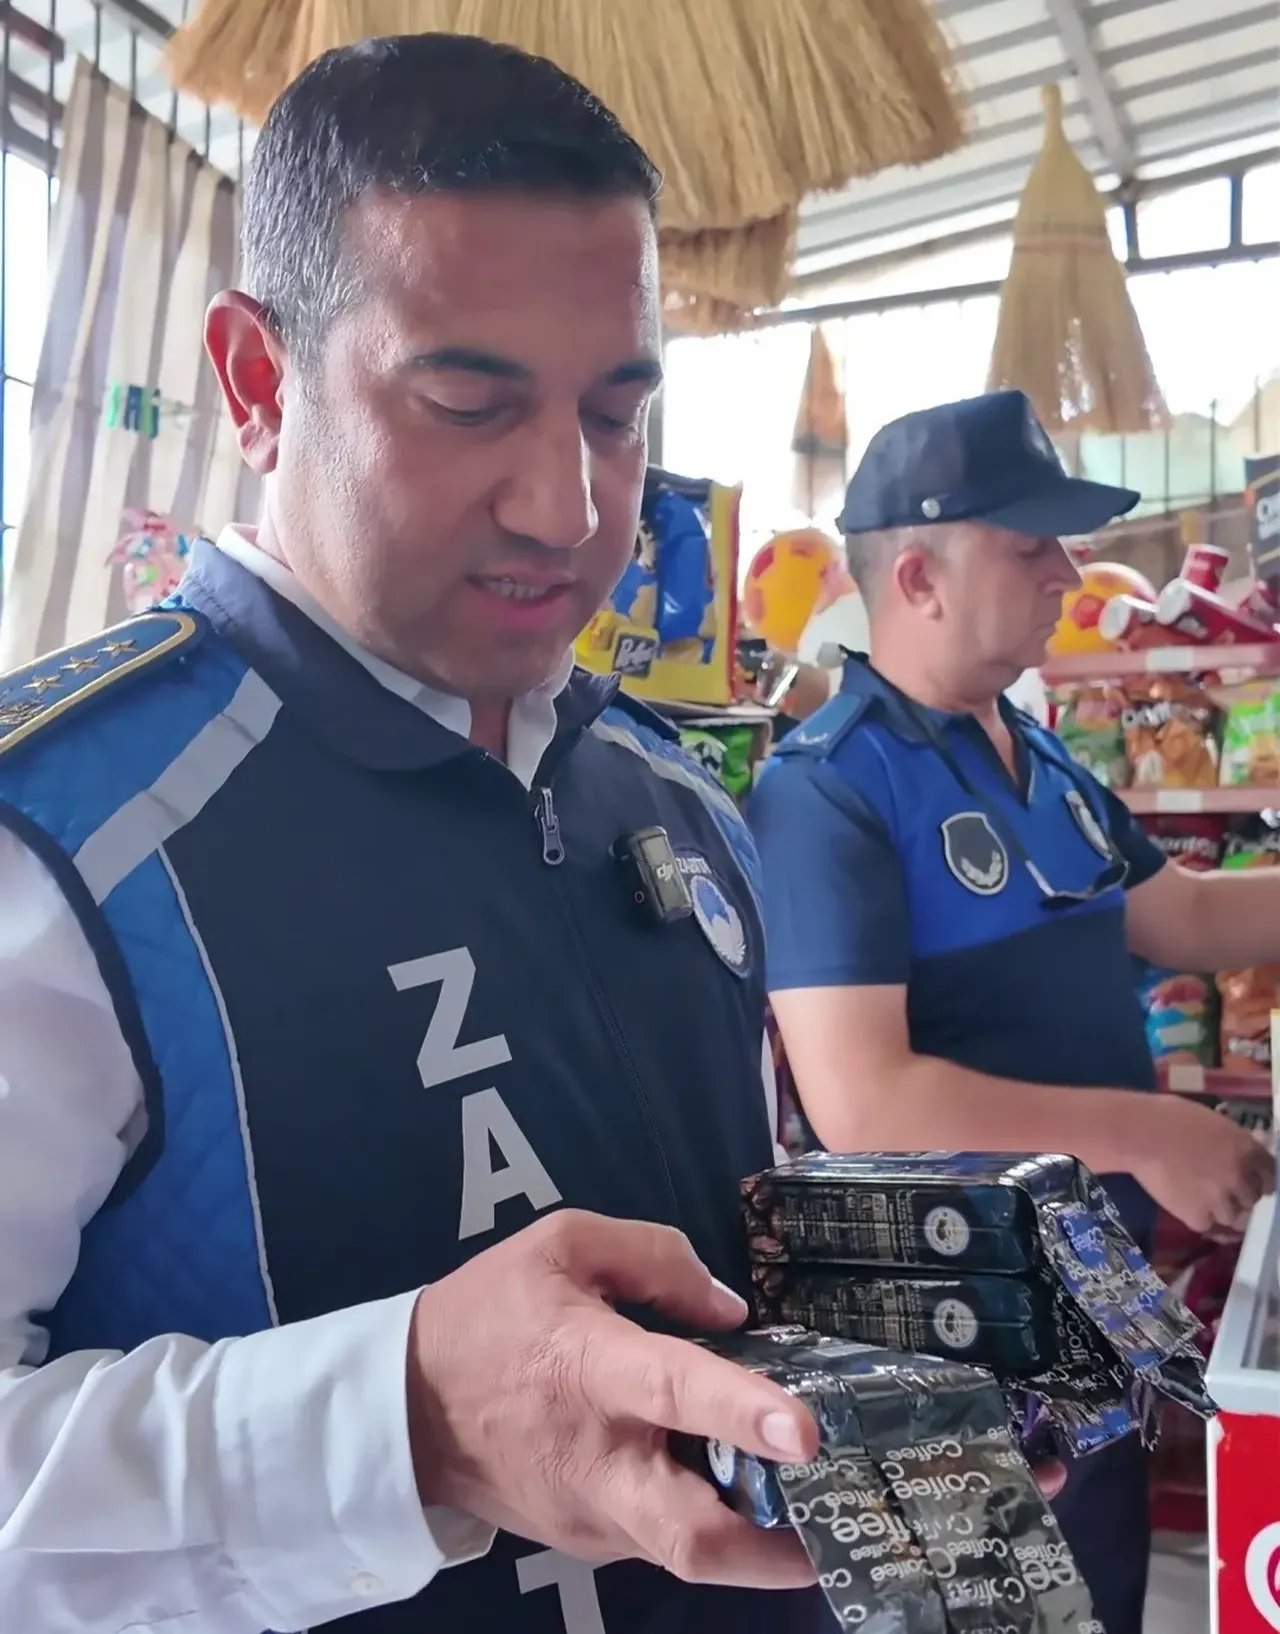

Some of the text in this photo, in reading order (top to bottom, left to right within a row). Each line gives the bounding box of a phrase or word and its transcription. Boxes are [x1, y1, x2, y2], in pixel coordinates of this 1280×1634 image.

[885, 1439, 963, 1462] Coffee
[891, 1471, 991, 1501] Coffee
[946, 1537, 1008, 1559] Coffee
